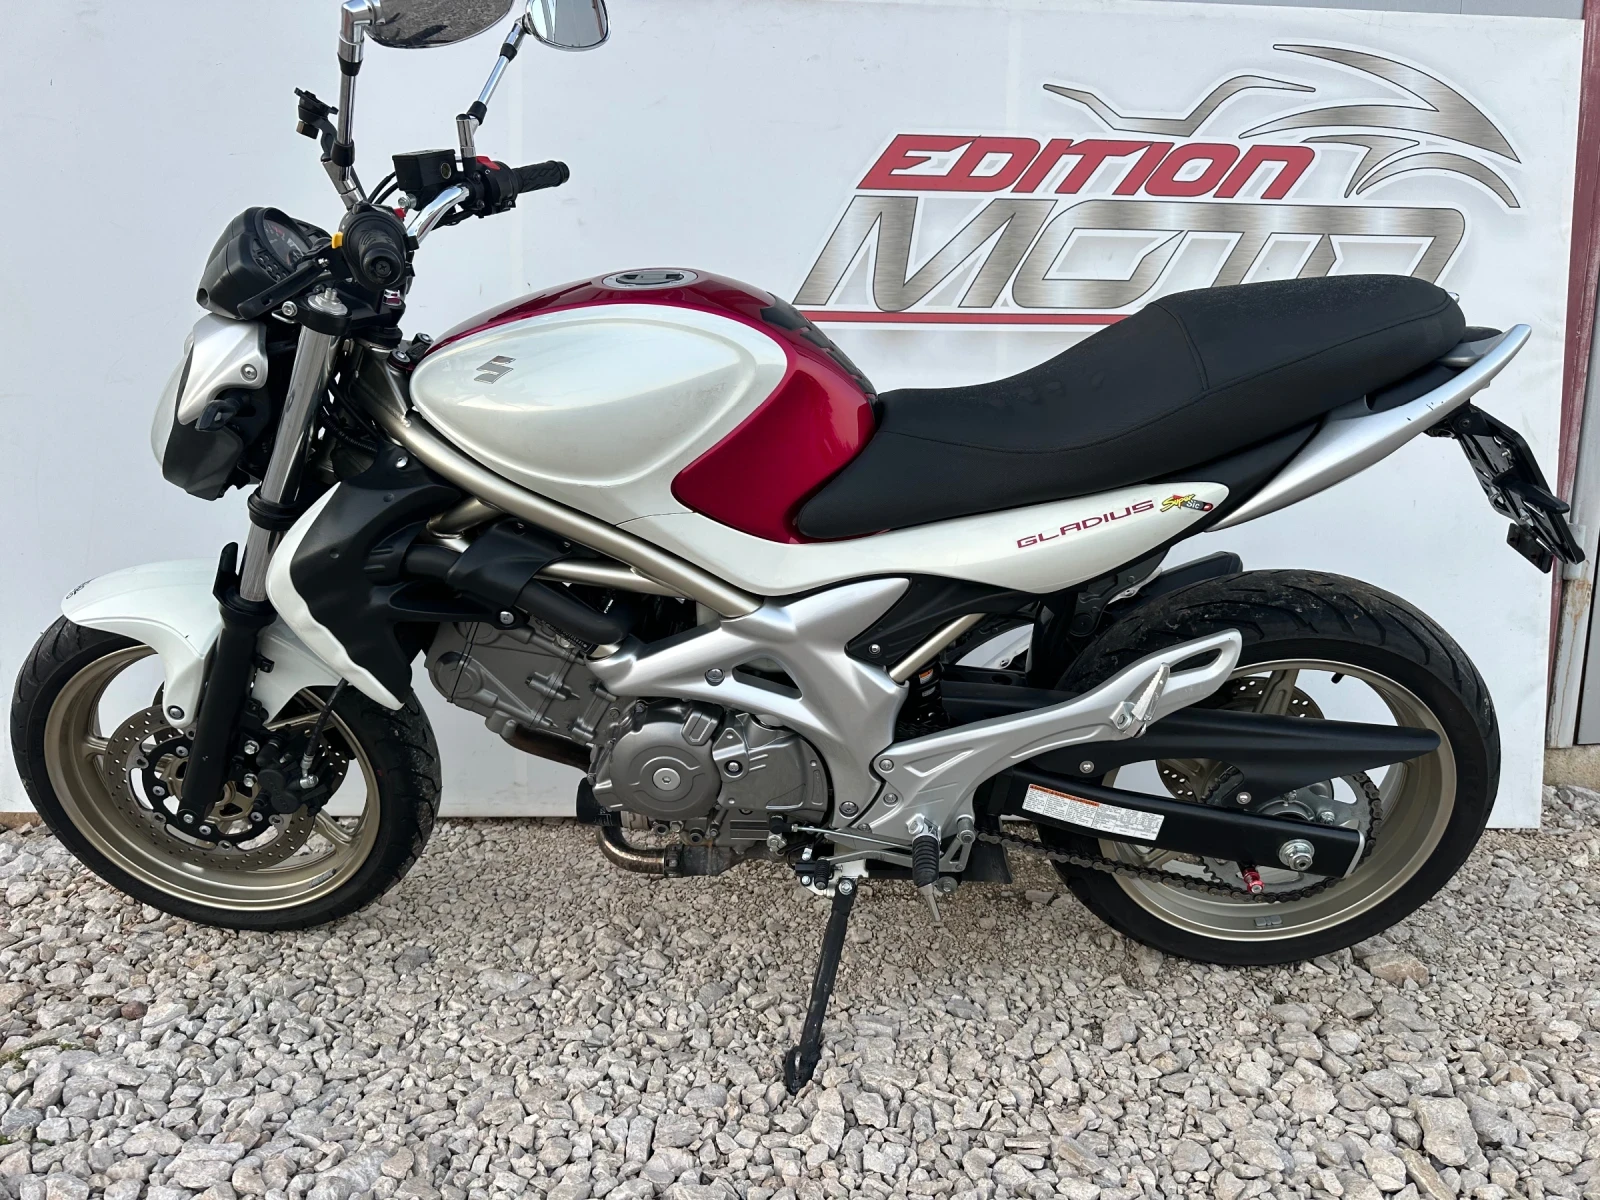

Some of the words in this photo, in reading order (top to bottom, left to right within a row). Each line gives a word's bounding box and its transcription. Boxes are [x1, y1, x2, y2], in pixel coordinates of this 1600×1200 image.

[856, 134, 1315, 200] EDITION
[791, 195, 1465, 312] MOTO
[1017, 500, 1154, 548] GLADIUS
